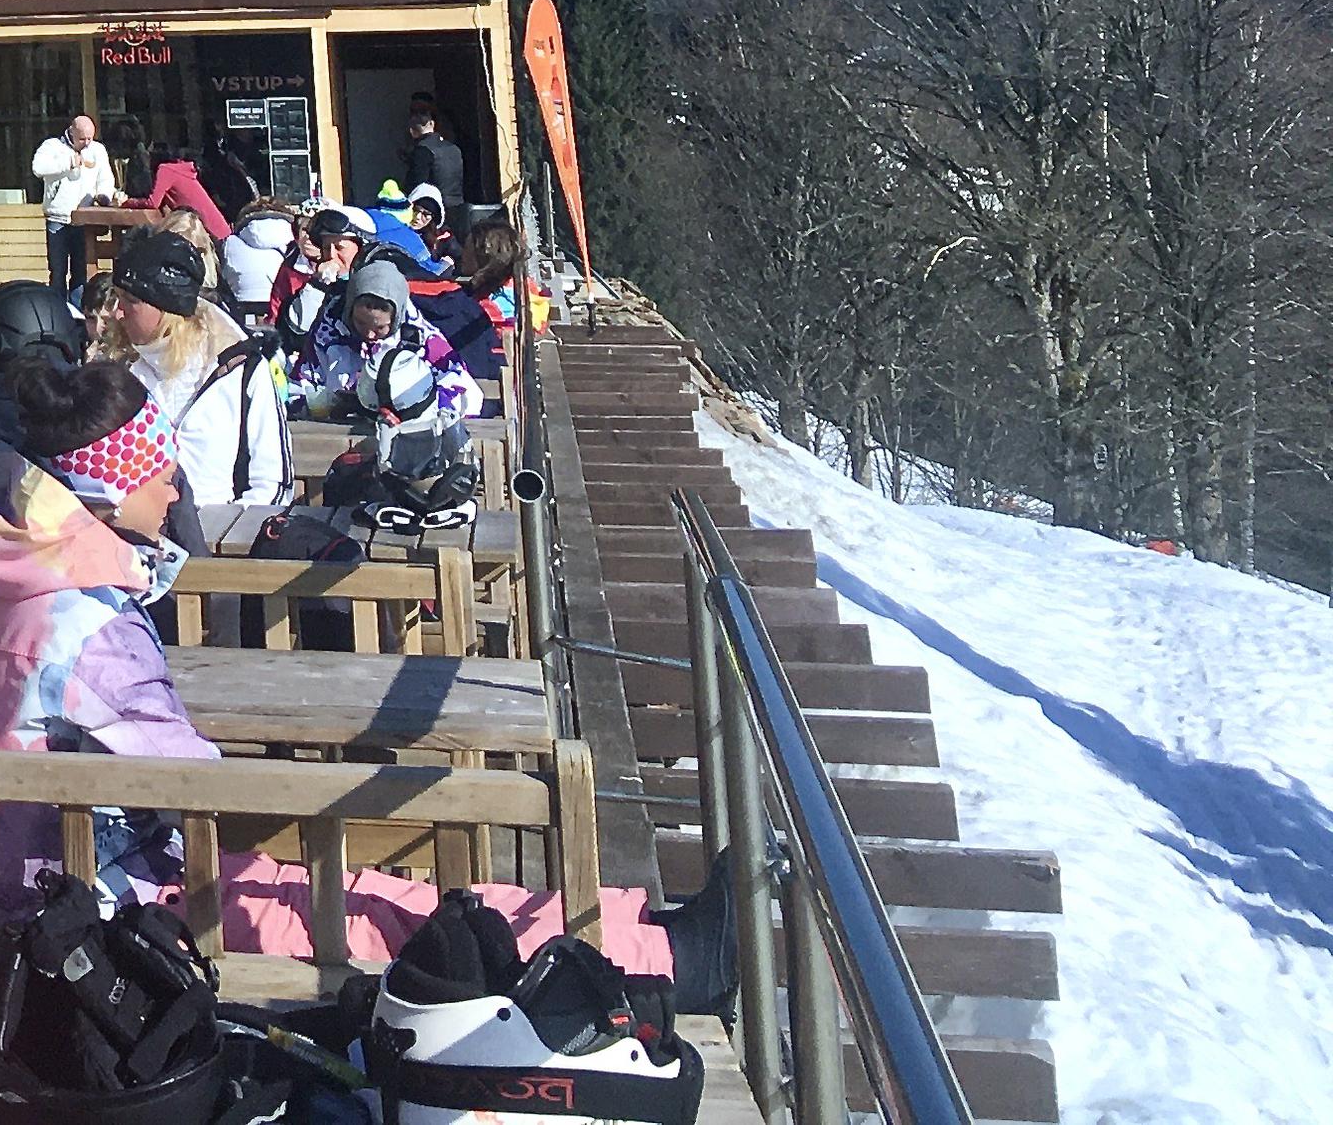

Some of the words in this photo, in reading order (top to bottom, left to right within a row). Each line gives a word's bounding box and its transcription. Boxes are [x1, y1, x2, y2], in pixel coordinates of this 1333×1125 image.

[101, 46, 135, 66] Red
[138, 45, 171, 65] Bull
[211, 75, 284, 92] VSTUP
